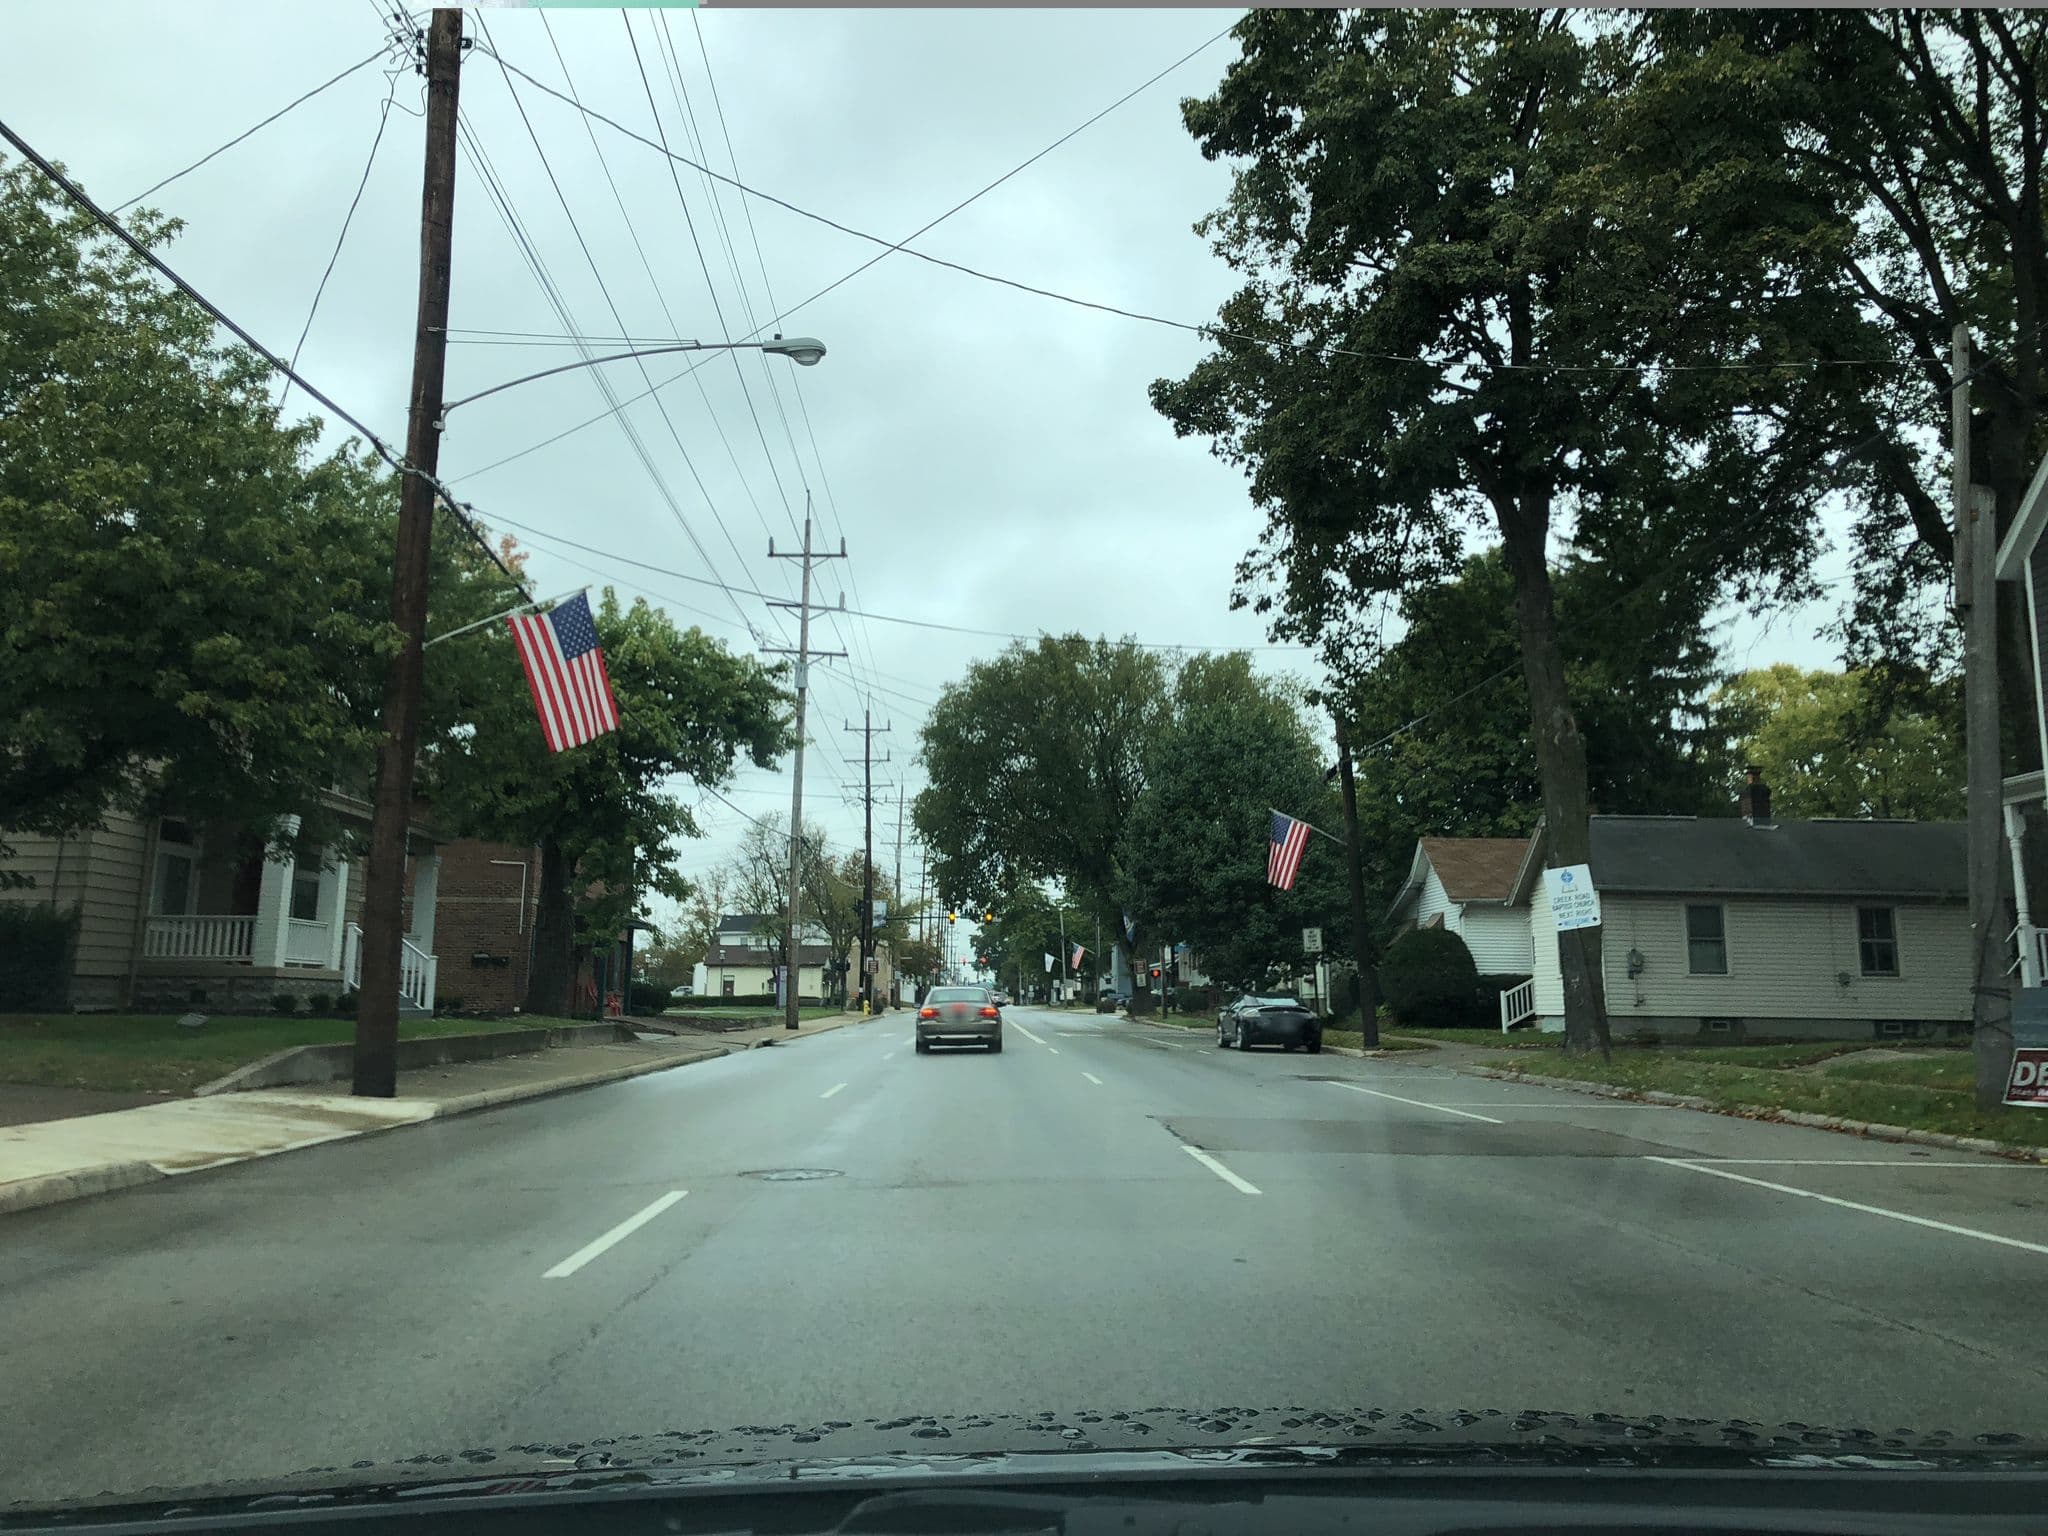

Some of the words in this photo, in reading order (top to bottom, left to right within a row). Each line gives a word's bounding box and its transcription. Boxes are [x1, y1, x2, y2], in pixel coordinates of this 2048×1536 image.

[1553, 895, 1573, 904] CREEK
[1574, 892, 1591, 900] ROAD
[1552, 902, 1573, 911] BAPTIST
[1574, 899, 1595, 908] CHURCH
[1576, 908, 1593, 917] RIGHT
